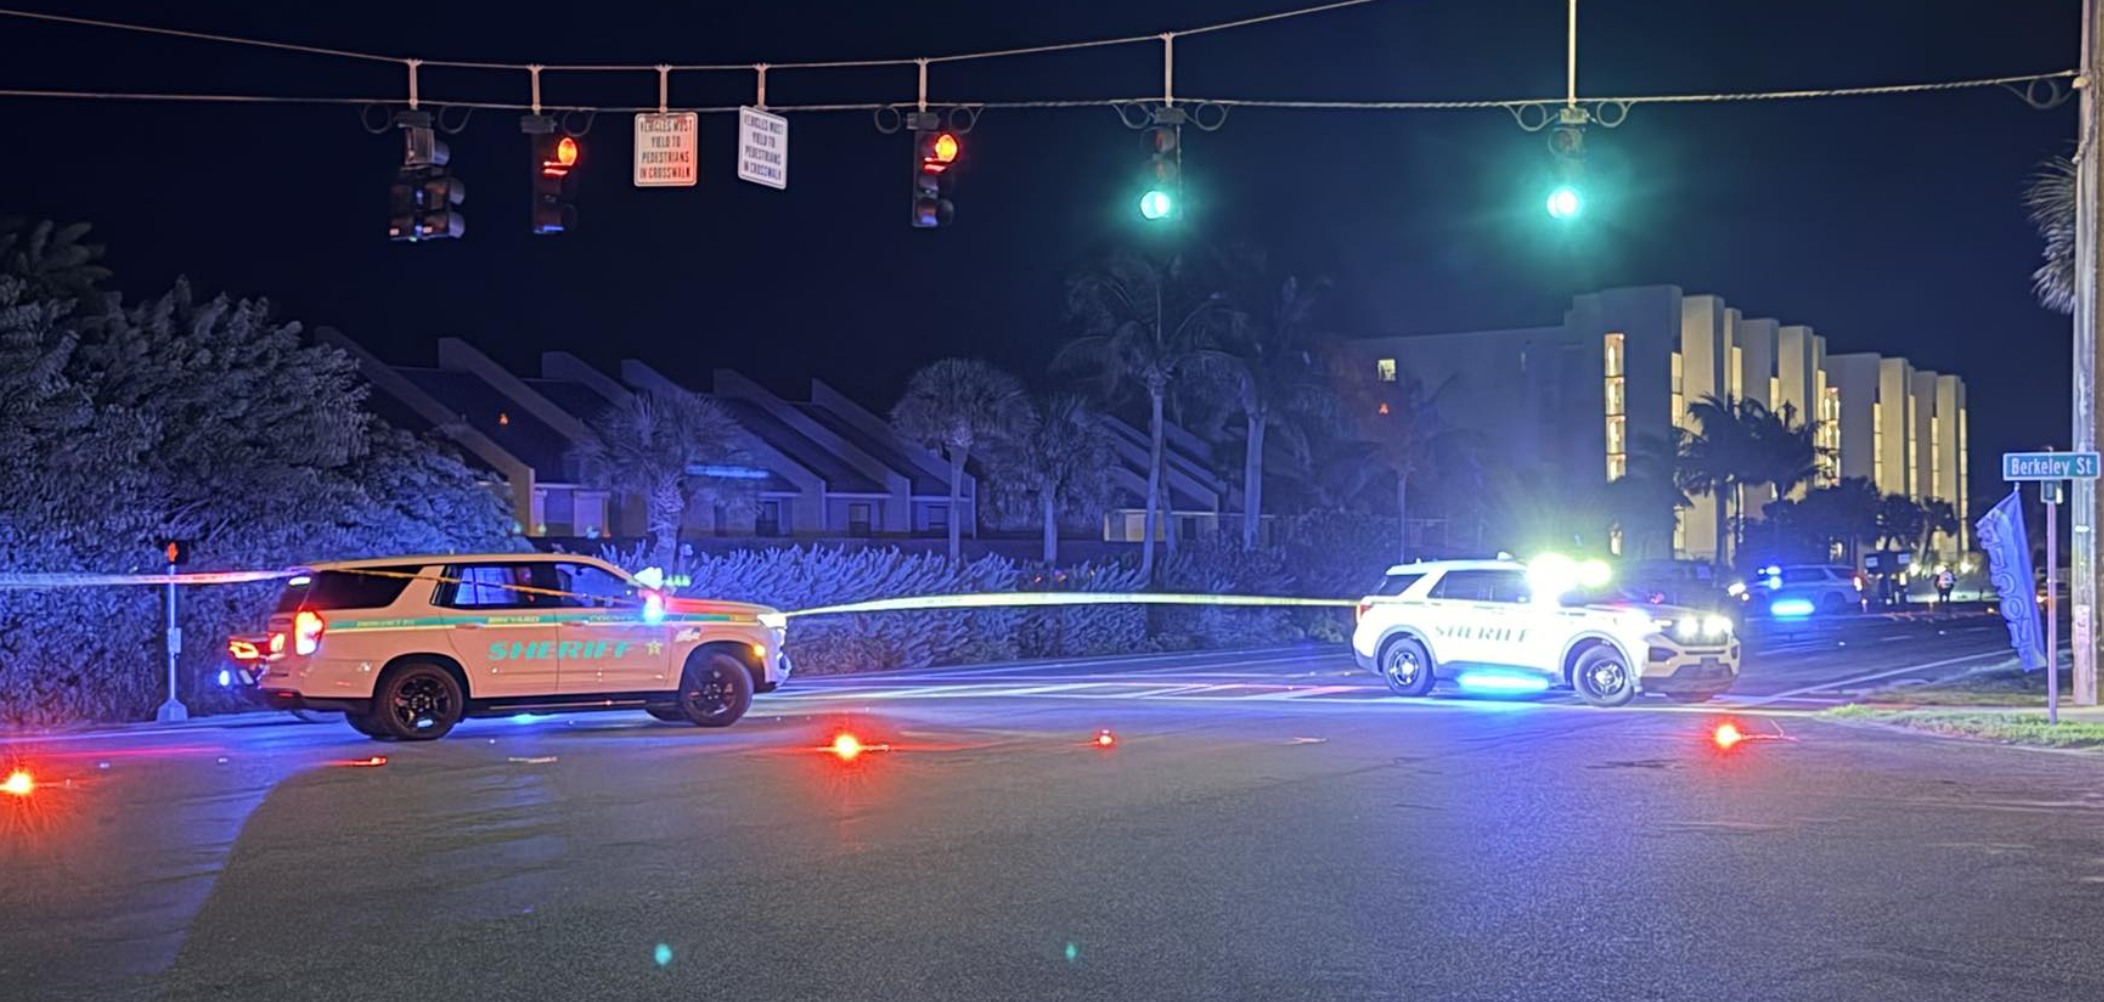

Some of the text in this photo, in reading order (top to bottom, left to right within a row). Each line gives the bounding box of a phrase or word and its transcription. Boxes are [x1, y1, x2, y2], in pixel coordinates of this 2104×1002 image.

[640, 119, 692, 132] VEHICLES MUST
[744, 114, 768, 131] VEHICLES
[651, 135, 681, 148] YIELD TO
[752, 132, 775, 149] YIELD TO
[641, 151, 689, 164] PEDESTRIANS
[745, 145, 781, 165] PEDESTRIANS
[640, 167, 690, 179] IN CROSSWALK
[2011, 457, 2092, 476] Berkeley St
[1435, 626, 1532, 642] SHERIFF
[487, 640, 632, 661] SHERIFF
